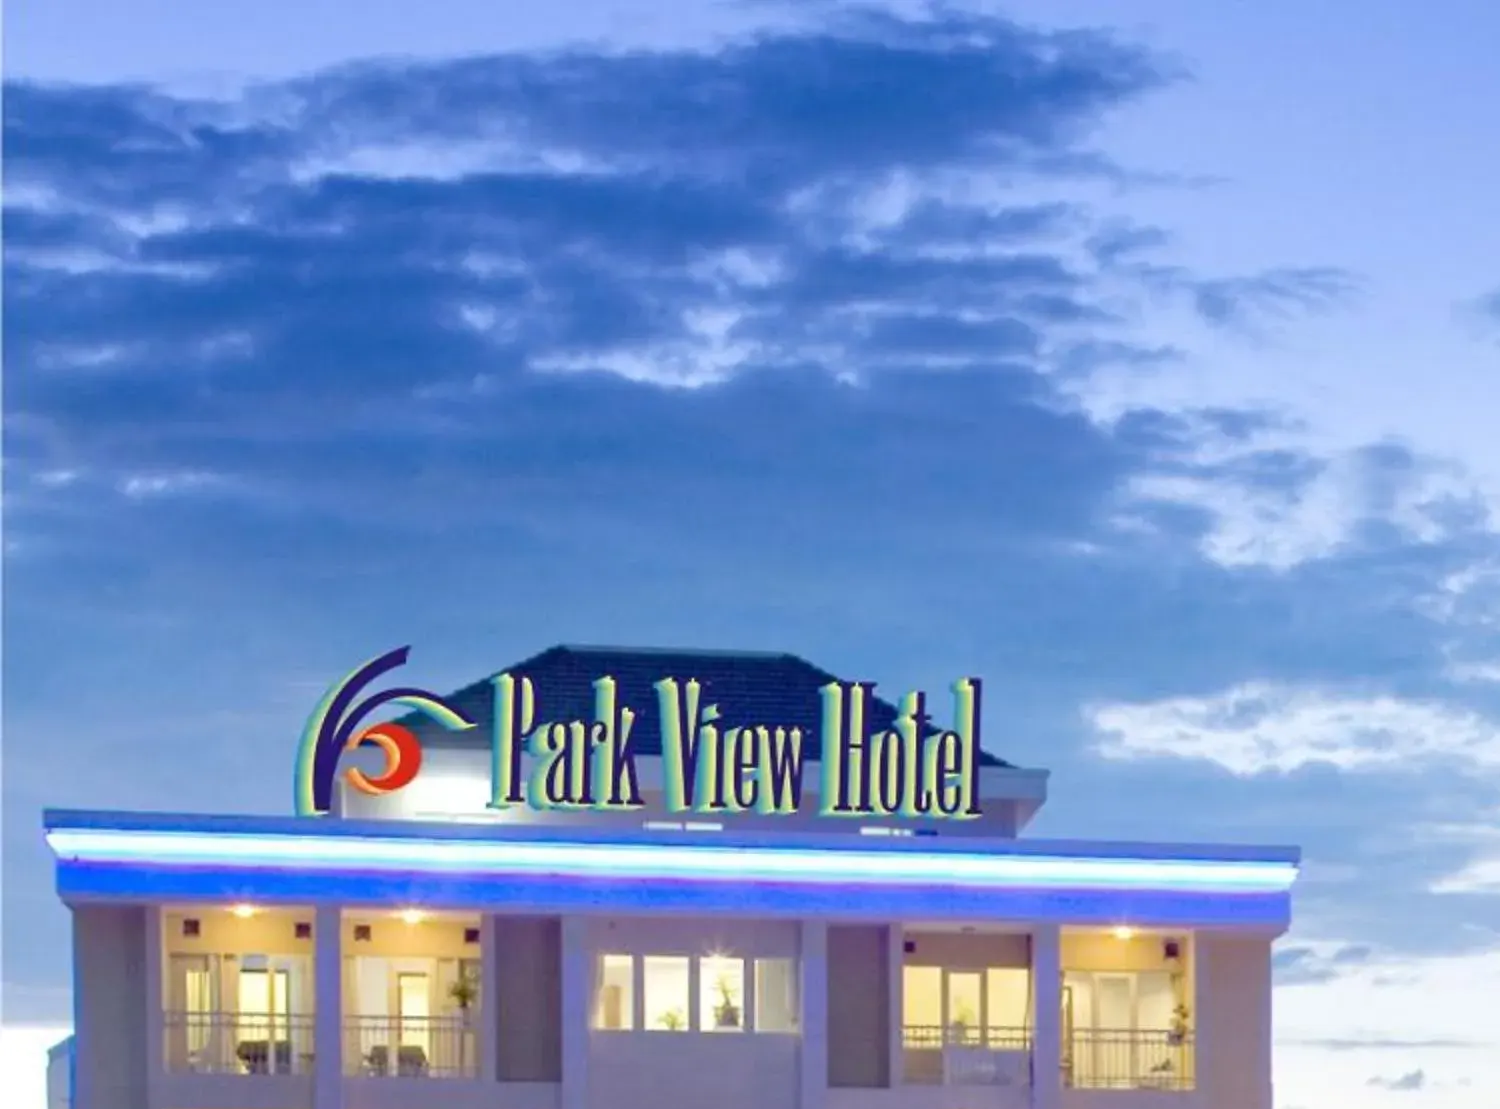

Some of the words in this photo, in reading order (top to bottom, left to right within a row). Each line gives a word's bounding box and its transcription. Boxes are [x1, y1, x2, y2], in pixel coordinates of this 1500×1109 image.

[486, 672, 646, 810] Park
[653, 676, 801, 814] View
[820, 676, 982, 818] Hotel
